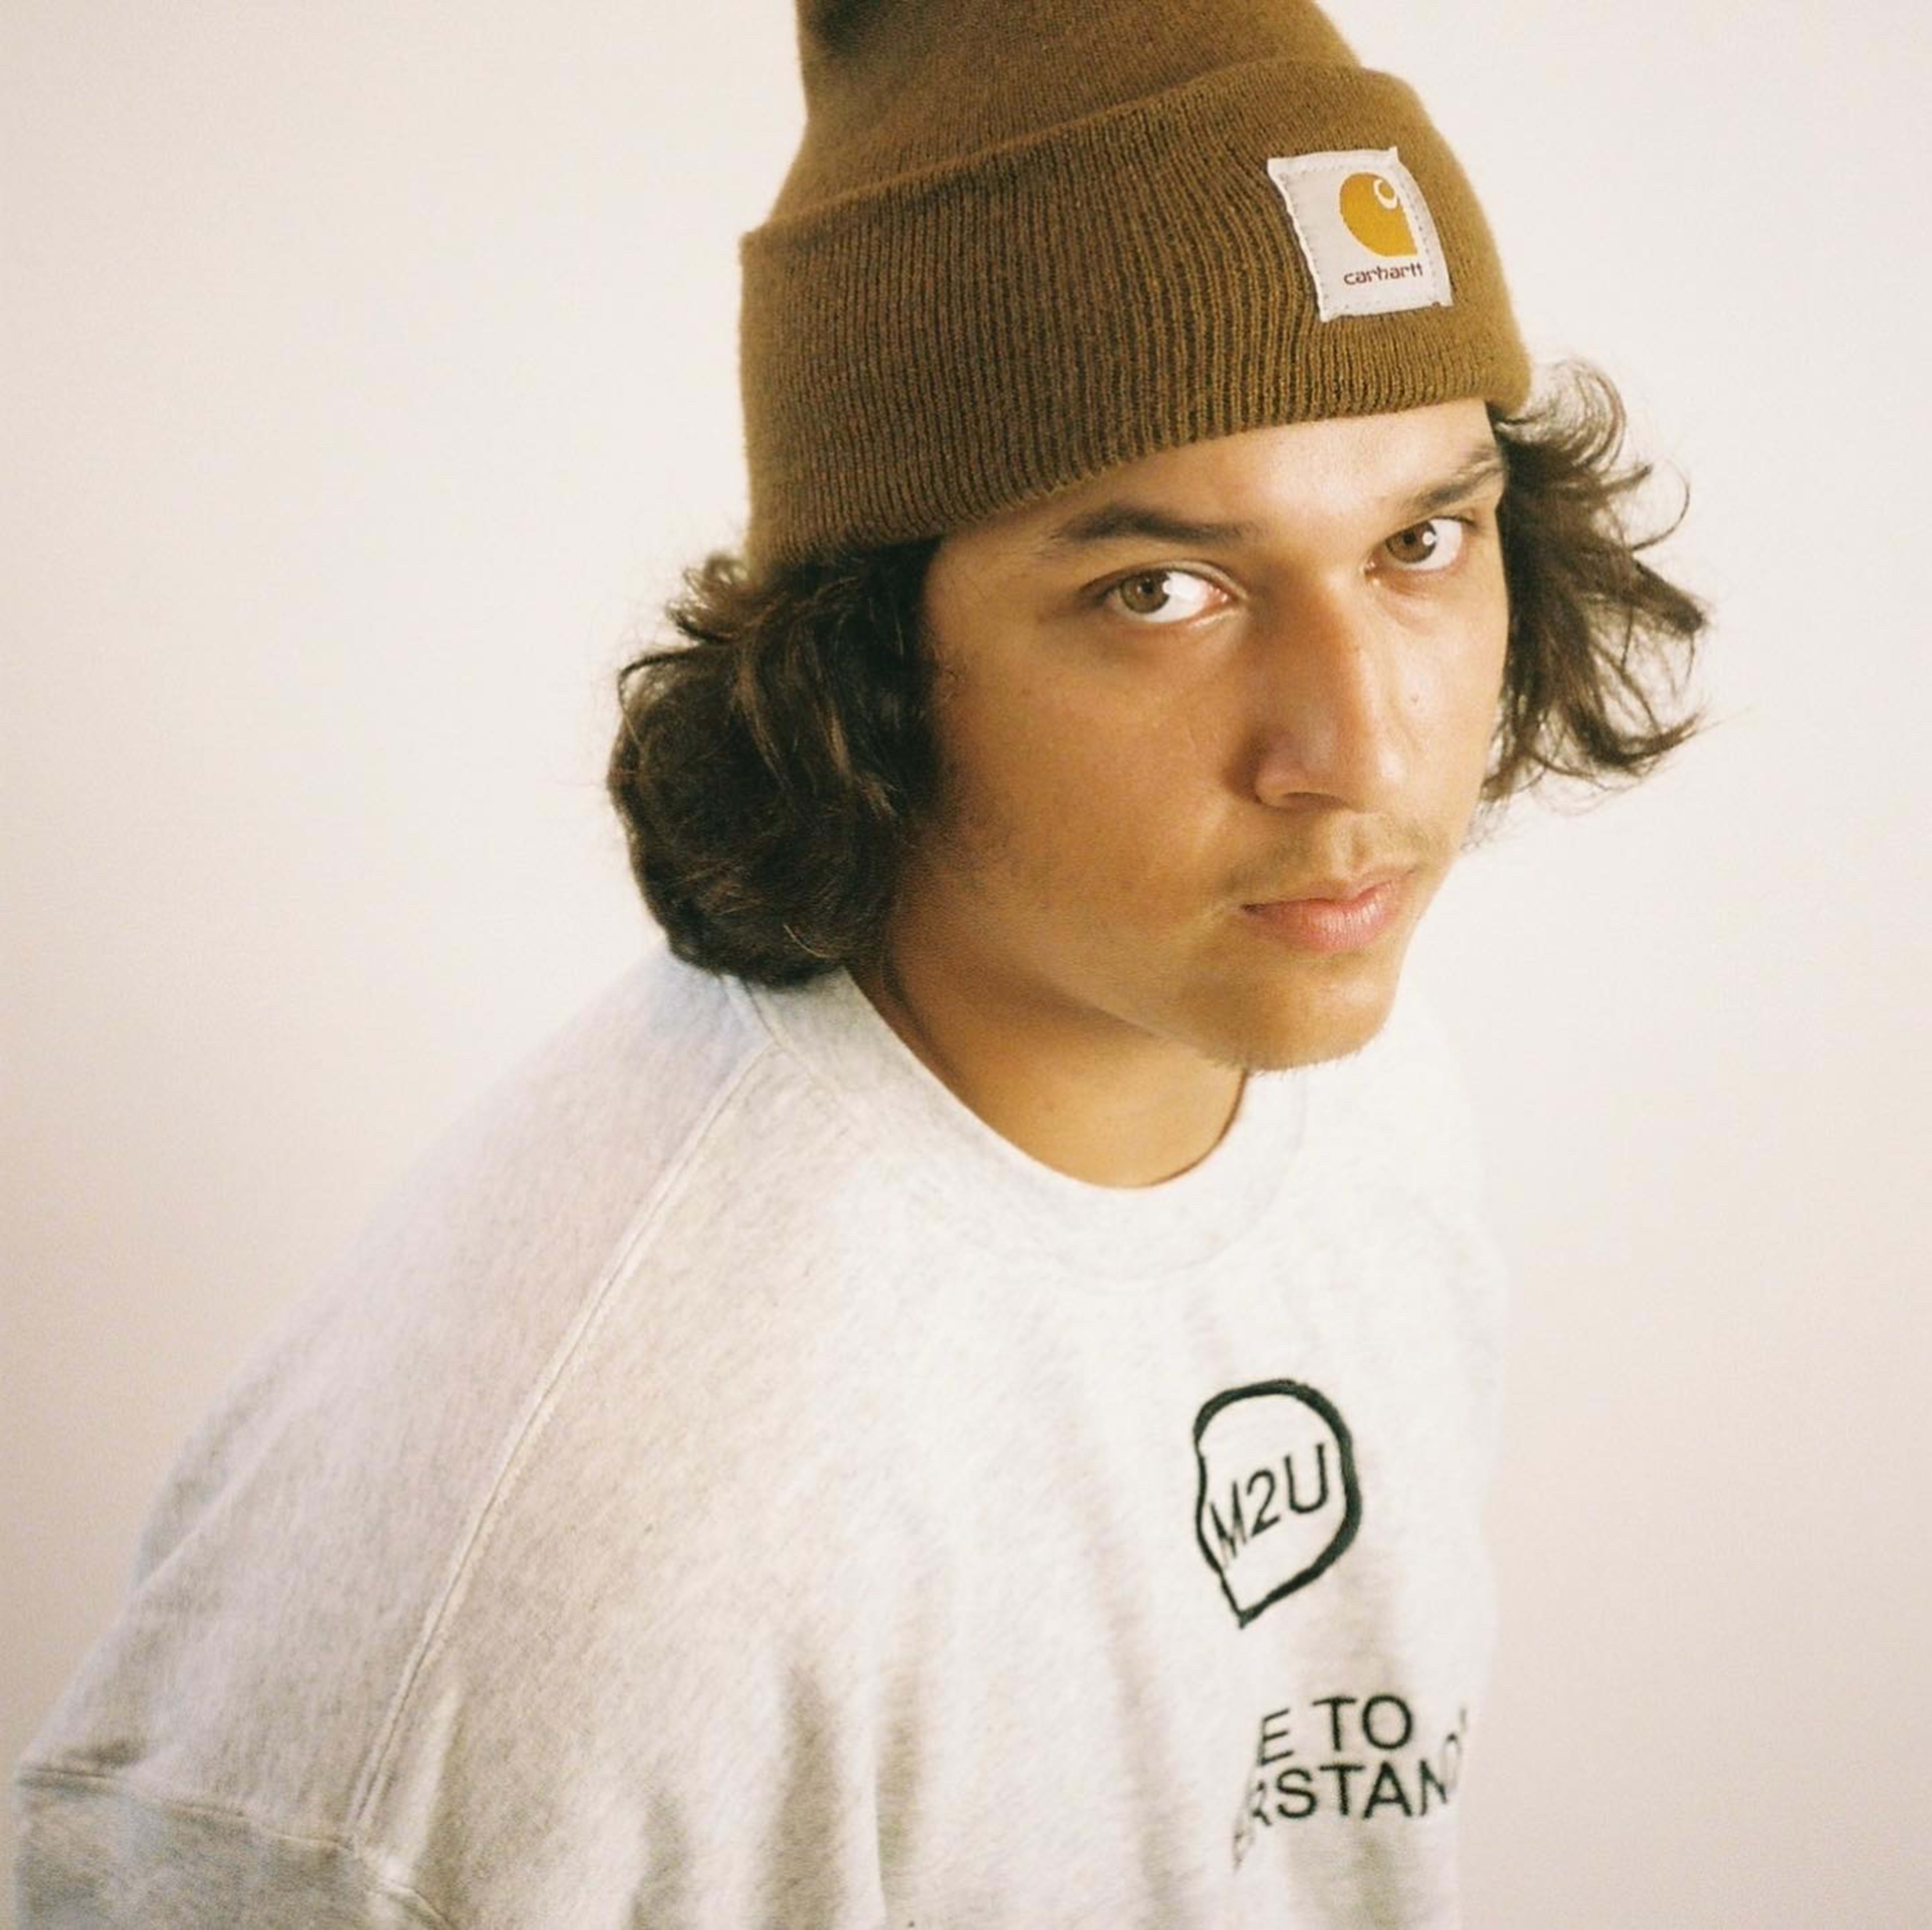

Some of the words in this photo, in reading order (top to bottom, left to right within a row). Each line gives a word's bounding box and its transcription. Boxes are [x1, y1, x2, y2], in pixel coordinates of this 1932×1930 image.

[1343, 263, 1423, 285] carhartt
[1209, 1442, 1329, 1567] M2U
[1312, 1693, 1414, 1752] TO
